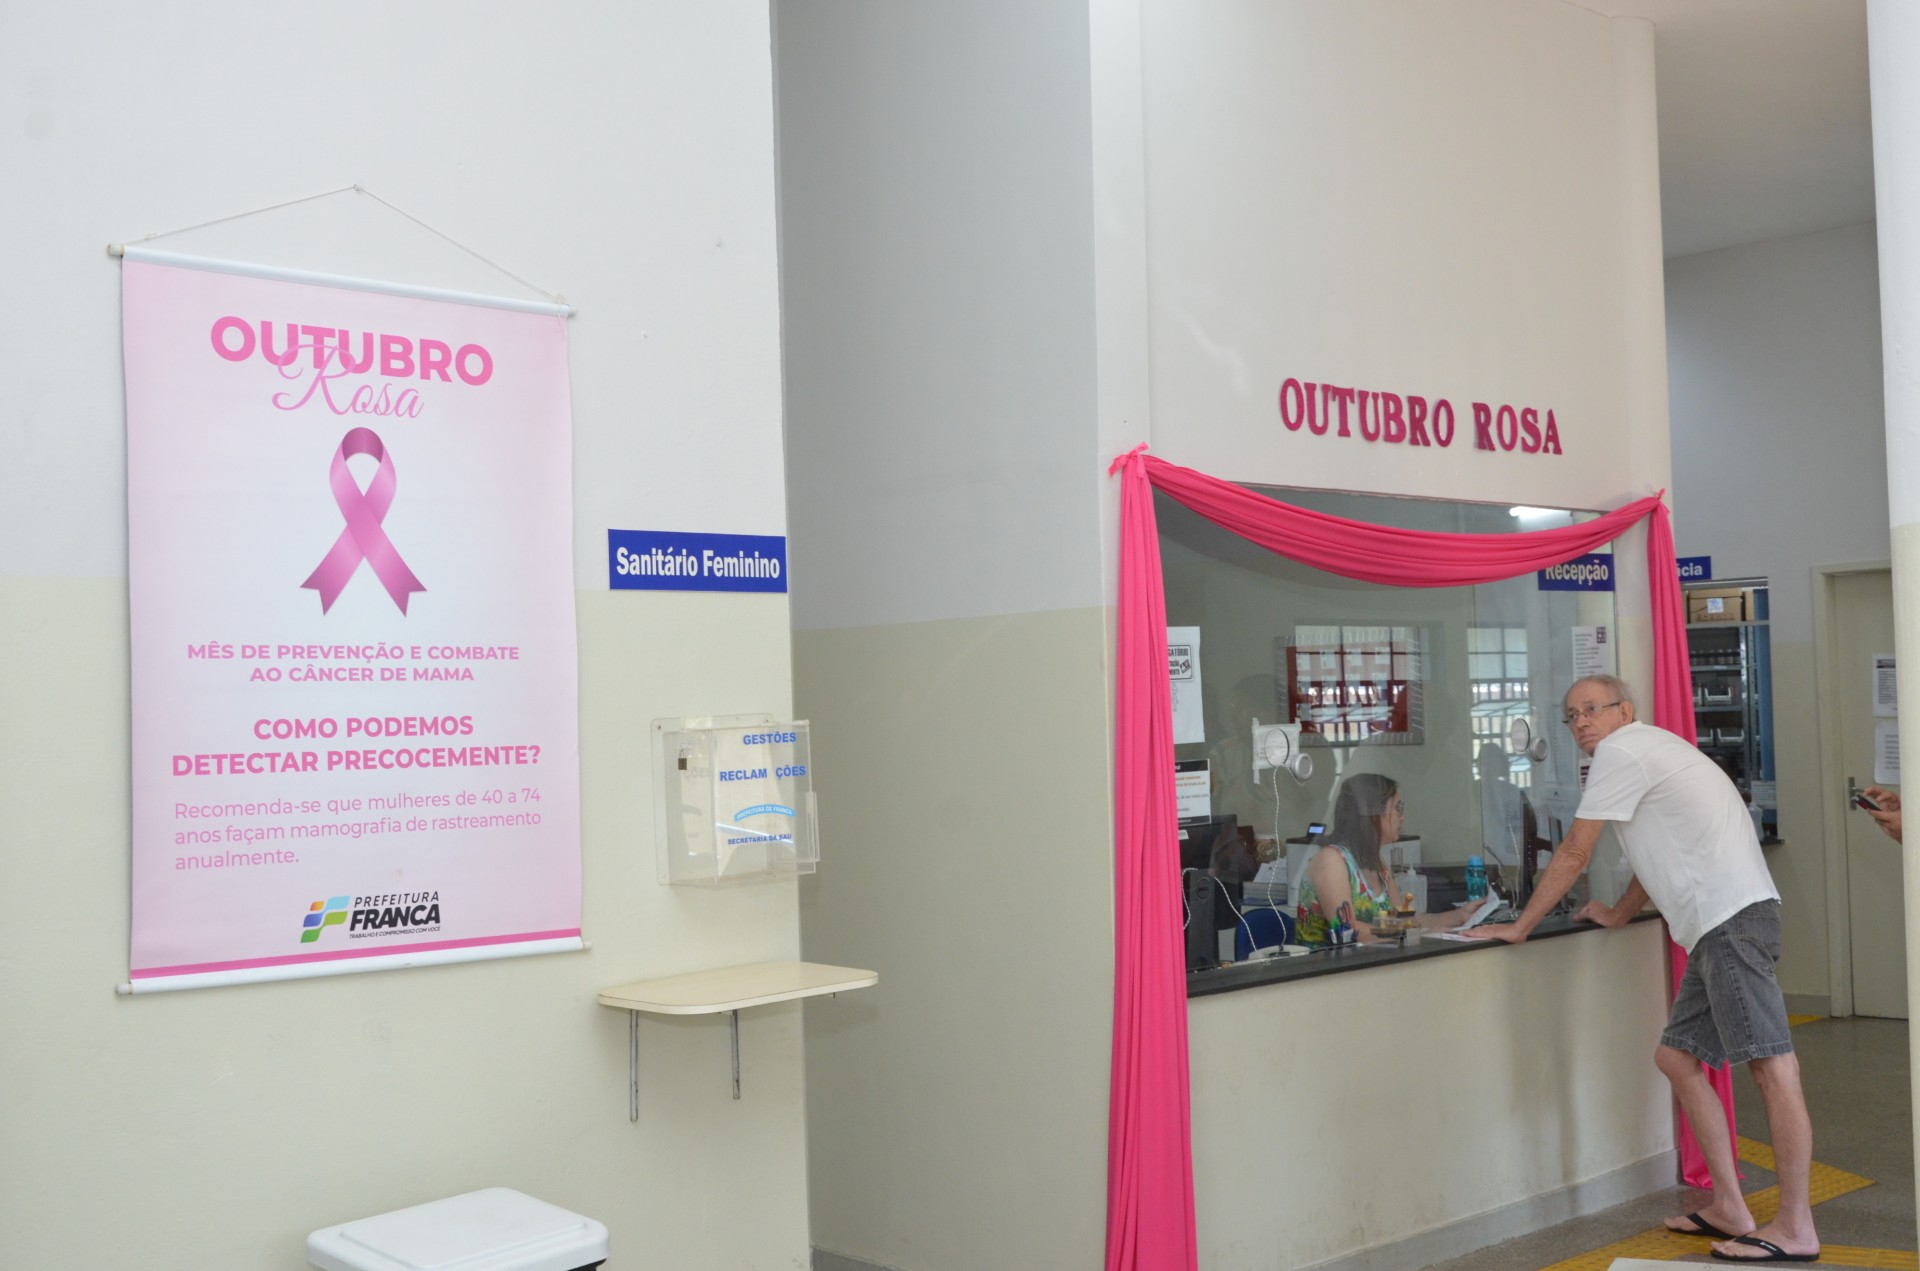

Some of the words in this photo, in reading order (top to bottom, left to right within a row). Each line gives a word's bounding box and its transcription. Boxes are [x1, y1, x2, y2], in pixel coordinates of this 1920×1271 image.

[210, 315, 494, 387] OUTUBRO
[271, 344, 425, 420] Rosa
[1279, 377, 1455, 448] OUTUBRO
[1472, 402, 1563, 455] ROSA
[616, 546, 699, 577] Sanitário
[703, 549, 781, 579] Feminino
[1545, 559, 1609, 586] Recepção
[187, 640, 235, 660] MÊS
[241, 644, 271, 660] DE
[277, 642, 405, 664] PREVENÇÃO
[410, 646, 422, 660] E
[427, 646, 520, 660] COMBATE
[250, 667, 282, 682] AO
[288, 663, 374, 682] CÂNCER
[380, 667, 407, 682] DE
[413, 667, 475, 681] MAMA
[253, 717, 338, 740] COMO
[346, 715, 474, 738] PODEMOS
[172, 751, 319, 777] DETECTAR
[327, 744, 541, 772] PRECOCEMENTE?
[719, 768, 767, 782] RECLAM
[775, 764, 806, 780] ÇÕES
[175, 798, 322, 819] Recomenda-se
[327, 798, 362, 815] que
[368, 793, 450, 811] mulheres
[455, 790, 477, 806] de
[482, 789, 503, 804] 40
[508, 791, 517, 803] a
[521, 788, 541, 803] 74
[175, 830, 222, 845] anos
[225, 825, 285, 845] façam
[290, 817, 402, 839] mamografia
[405, 816, 428, 832] de
[432, 812, 542, 830] rastreamento
[728, 836, 768, 845] SECRETARIA
[175, 849, 300, 870] anualmente.
[354, 891, 440, 907] PREFEITURA
[349, 904, 440, 931] FRANCA
[379, 929, 415, 937] COMPROMISSO
